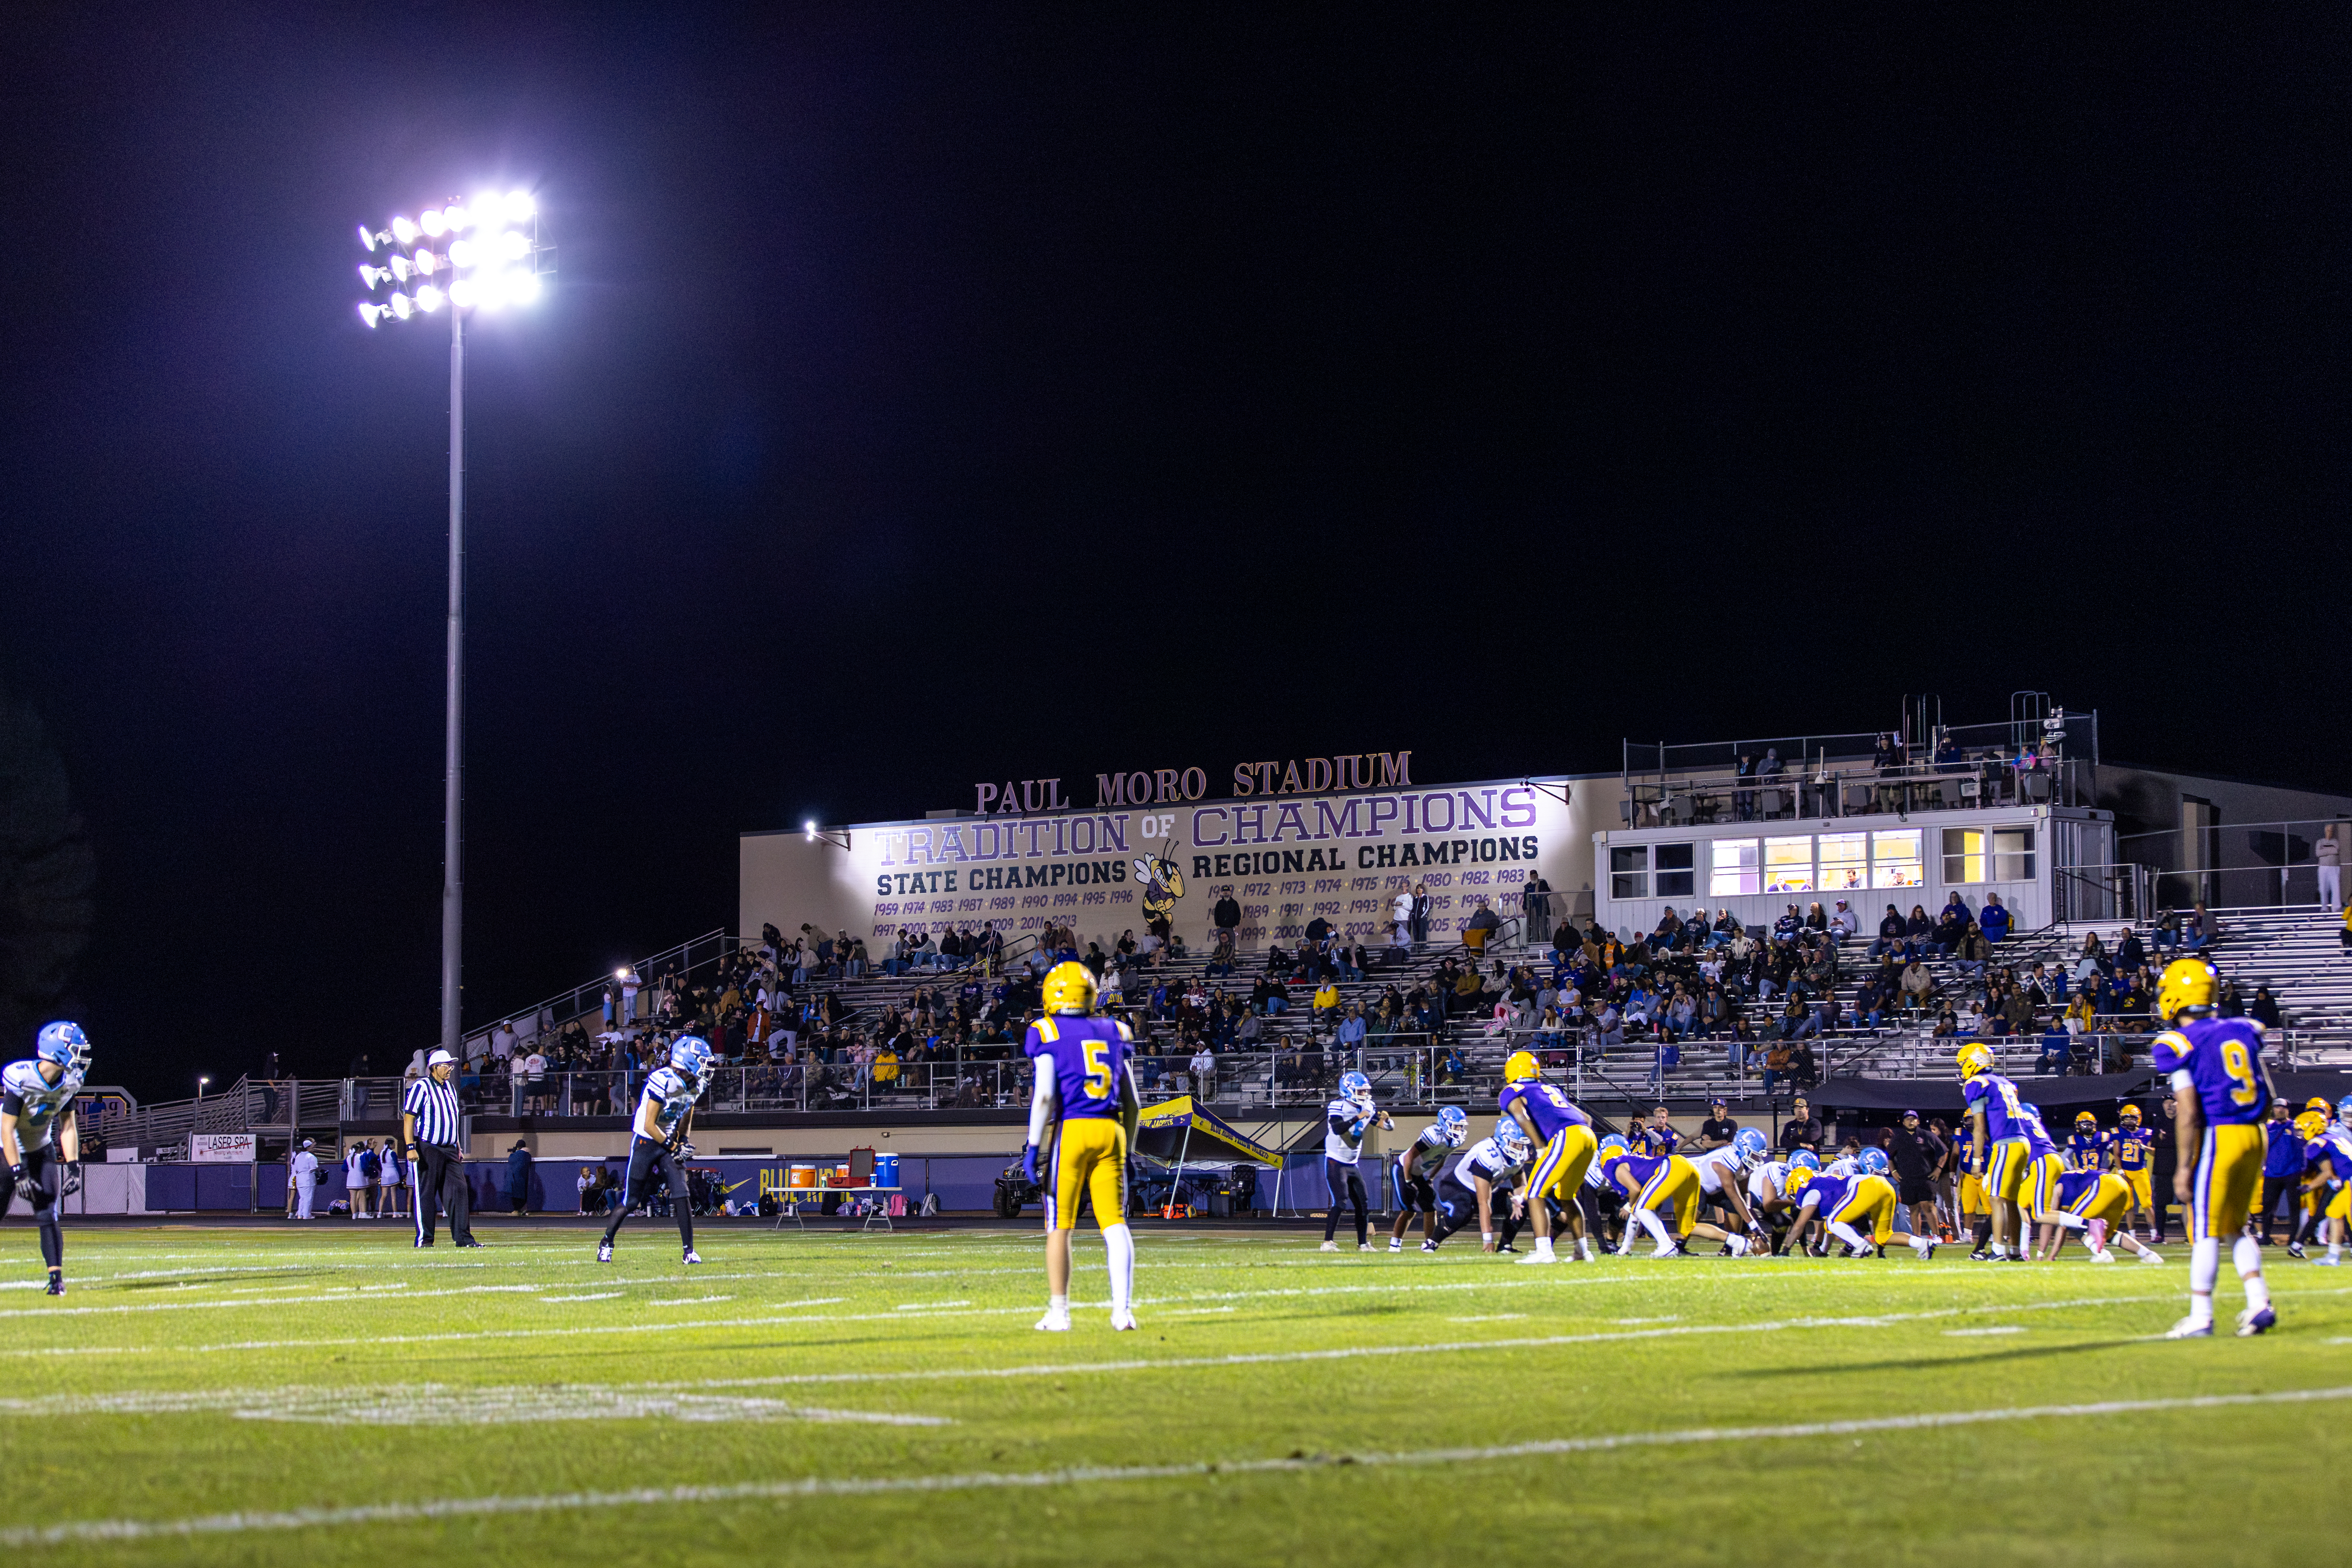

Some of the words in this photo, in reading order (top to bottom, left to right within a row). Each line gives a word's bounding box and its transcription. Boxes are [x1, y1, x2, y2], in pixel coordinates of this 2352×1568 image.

[974, 778, 1069, 815] PAUL
[1095, 767, 1206, 807] MORO
[1234, 751, 1412, 796] STADIUM
[873, 814, 1130, 867] TRADITION
[1141, 814, 1175, 838] OF
[1192, 788, 1536, 848] CHAMPIONS
[1193, 848, 1346, 878] REGIONAL
[1358, 836, 1538, 869] CHAMPIONS
[877, 869, 958, 896] STATE
[969, 860, 1126, 891] CHAMPIONS
[1208, 884, 1235, 899] 199
[1243, 882, 1271, 897] 1972
[1279, 880, 1306, 895] 1973
[1314, 878, 1342, 893] 1974
[1351, 876, 1378, 891] 1975
[1421, 872, 1452, 887] 1980
[1461, 871, 1489, 885] 1982
[1497, 869, 1525, 883] 1983
[874, 903, 899, 916] 1959
[903, 901, 925, 915] 1974
[930, 899, 954, 914] 1983
[958, 898, 983, 912] 1987
[989, 896, 1015, 910] 1989
[1021, 895, 1048, 908] 1990
[1053, 893, 1078, 907] 1994
[1082, 891, 1106, 905] 1995
[1110, 890, 1133, 904] 1996
[1242, 905, 1270, 918] 1989
[1279, 903, 1304, 917] 1991
[1312, 901, 1341, 916] 1992
[1349, 899, 1378, 914] 1993
[872, 924, 896, 936] 1997
[901, 922, 927, 935] 2000
[957, 919, 983, 933] 2004
[1020, 916, 1044, 930] 2011
[1207, 928, 1218, 942] 19
[1240, 926, 1267, 941] 1999
[1273, 924, 1305, 940] 2000
[1344, 921, 1375, 936] 2002
[1427, 917, 1450, 932] 005
[1456, 917, 1472, 931] 20
[58, 1024, 73, 1042] C
[689, 1040, 702, 1055] C
[1080, 1040, 1113, 1100] 5
[2220, 1039, 2257, 1107] 9
[208, 1136, 232, 1149] LASER
[234, 1136, 249, 1149] SPA
[1741, 1131, 1756, 1143] C
[2081, 1153, 2099, 1170] 13
[2121, 1142, 2139, 1163] 21
